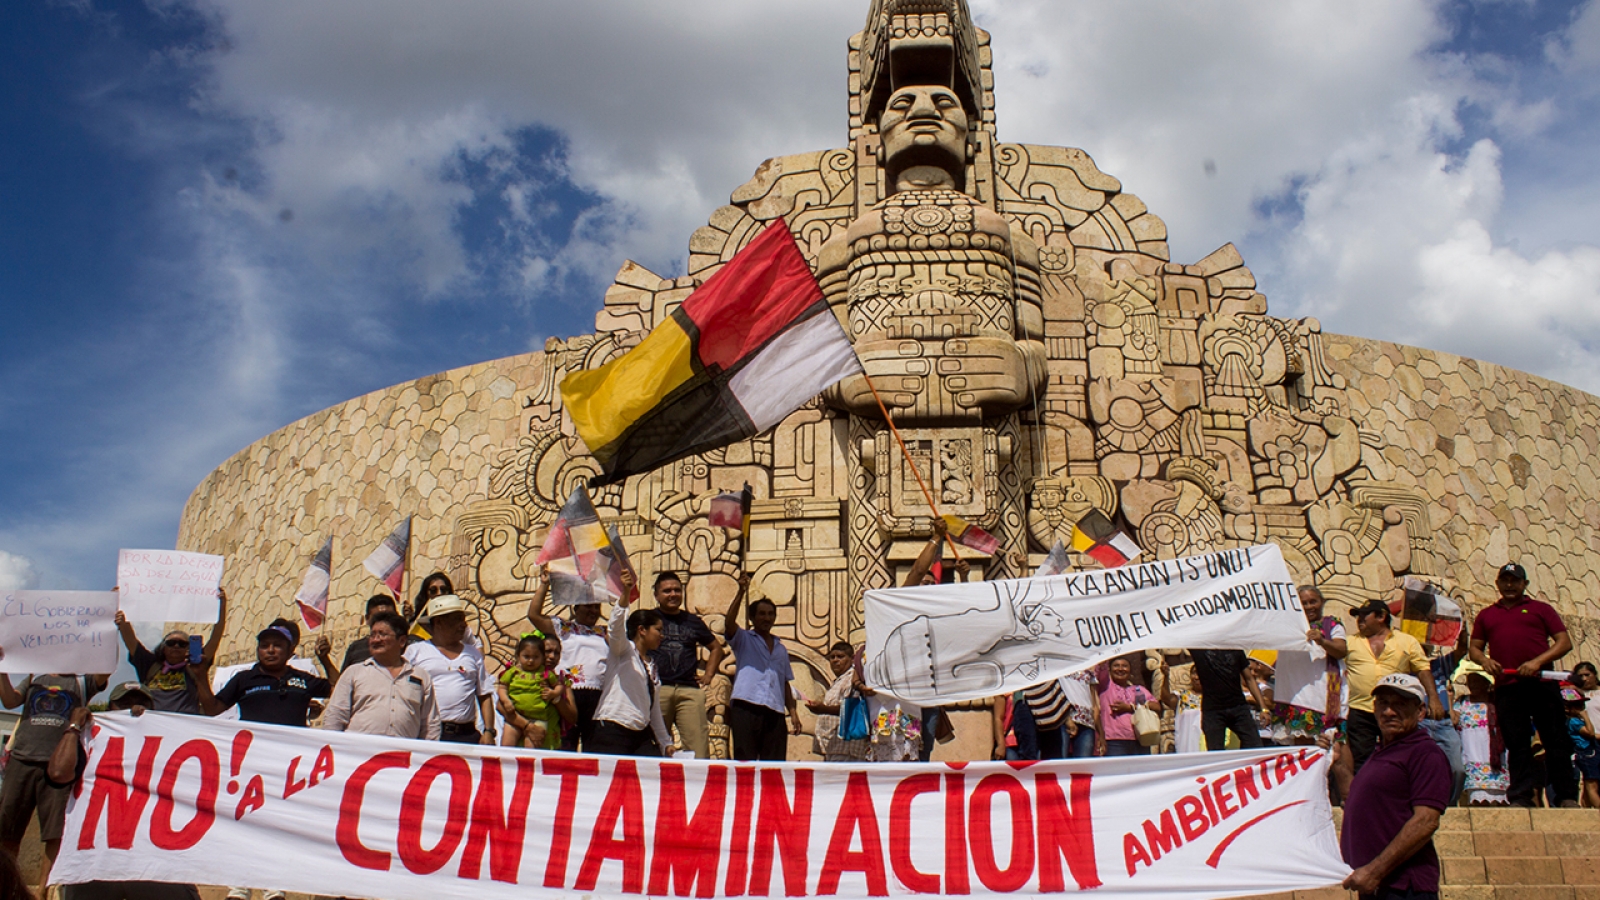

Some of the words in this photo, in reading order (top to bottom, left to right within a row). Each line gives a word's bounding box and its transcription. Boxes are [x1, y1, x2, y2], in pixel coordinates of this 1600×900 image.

[124, 552, 151, 564] POR
[156, 554, 173, 565] LA
[179, 555, 220, 569] DEFEN
[121, 567, 140, 577] SA
[146, 569, 173, 579] DEL
[180, 570, 217, 581] AGUA
[139, 584, 167, 594] DEL
[4, 595, 31, 616] EL
[44, 621, 71, 630] NOS
[1074, 614, 1131, 649] CUIDA
[236, 775, 264, 820] A
[283, 744, 335, 799] LA
[1123, 748, 1324, 877] AMBIENTAL
